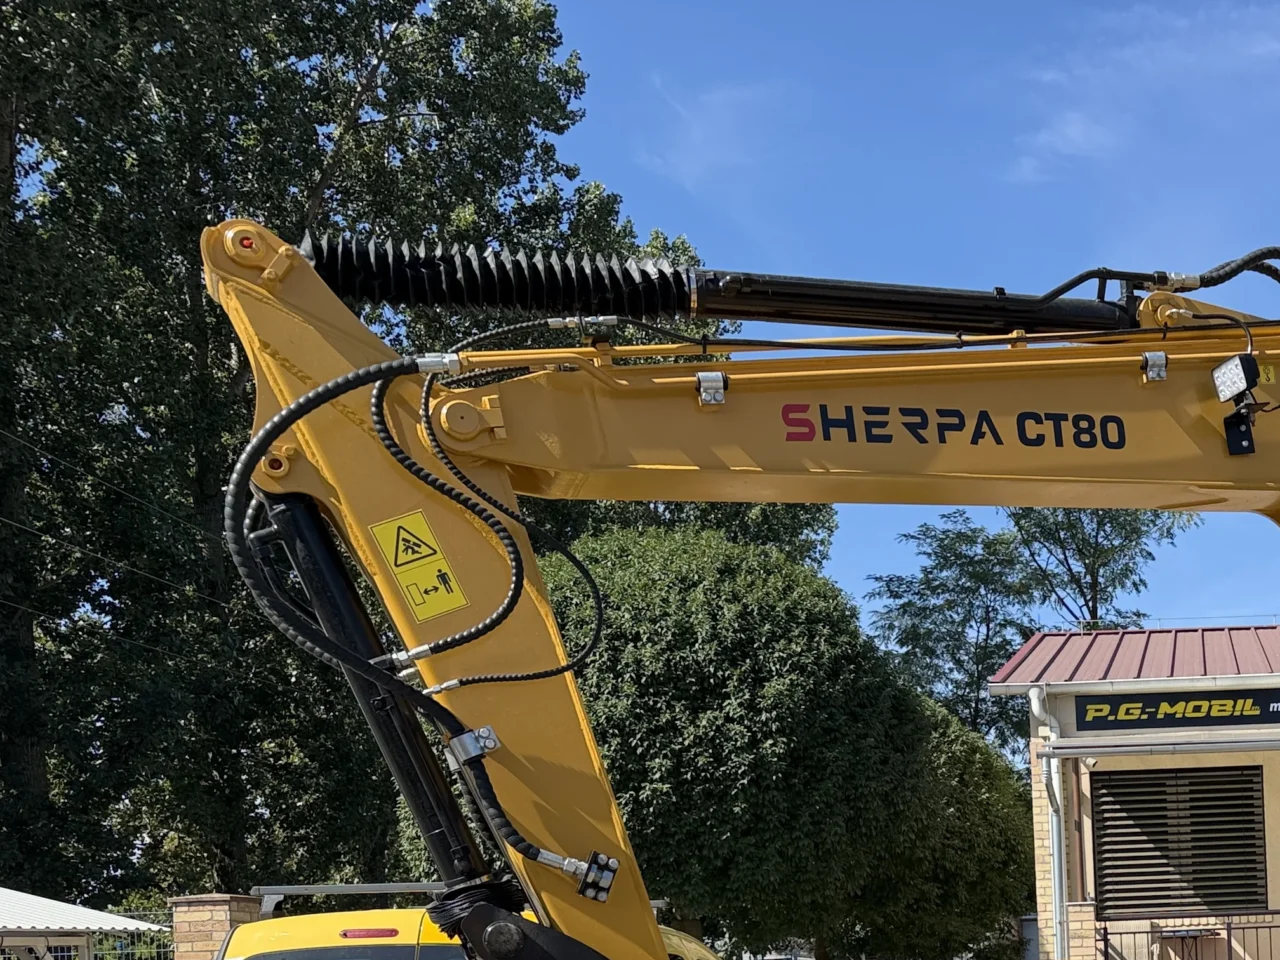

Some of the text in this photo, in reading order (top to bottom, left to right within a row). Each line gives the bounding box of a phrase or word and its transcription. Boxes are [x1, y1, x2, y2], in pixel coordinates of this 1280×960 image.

[781, 404, 1126, 450] SHERPA CT80
[1085, 698, 1260, 722] P.G.-MOBIL
